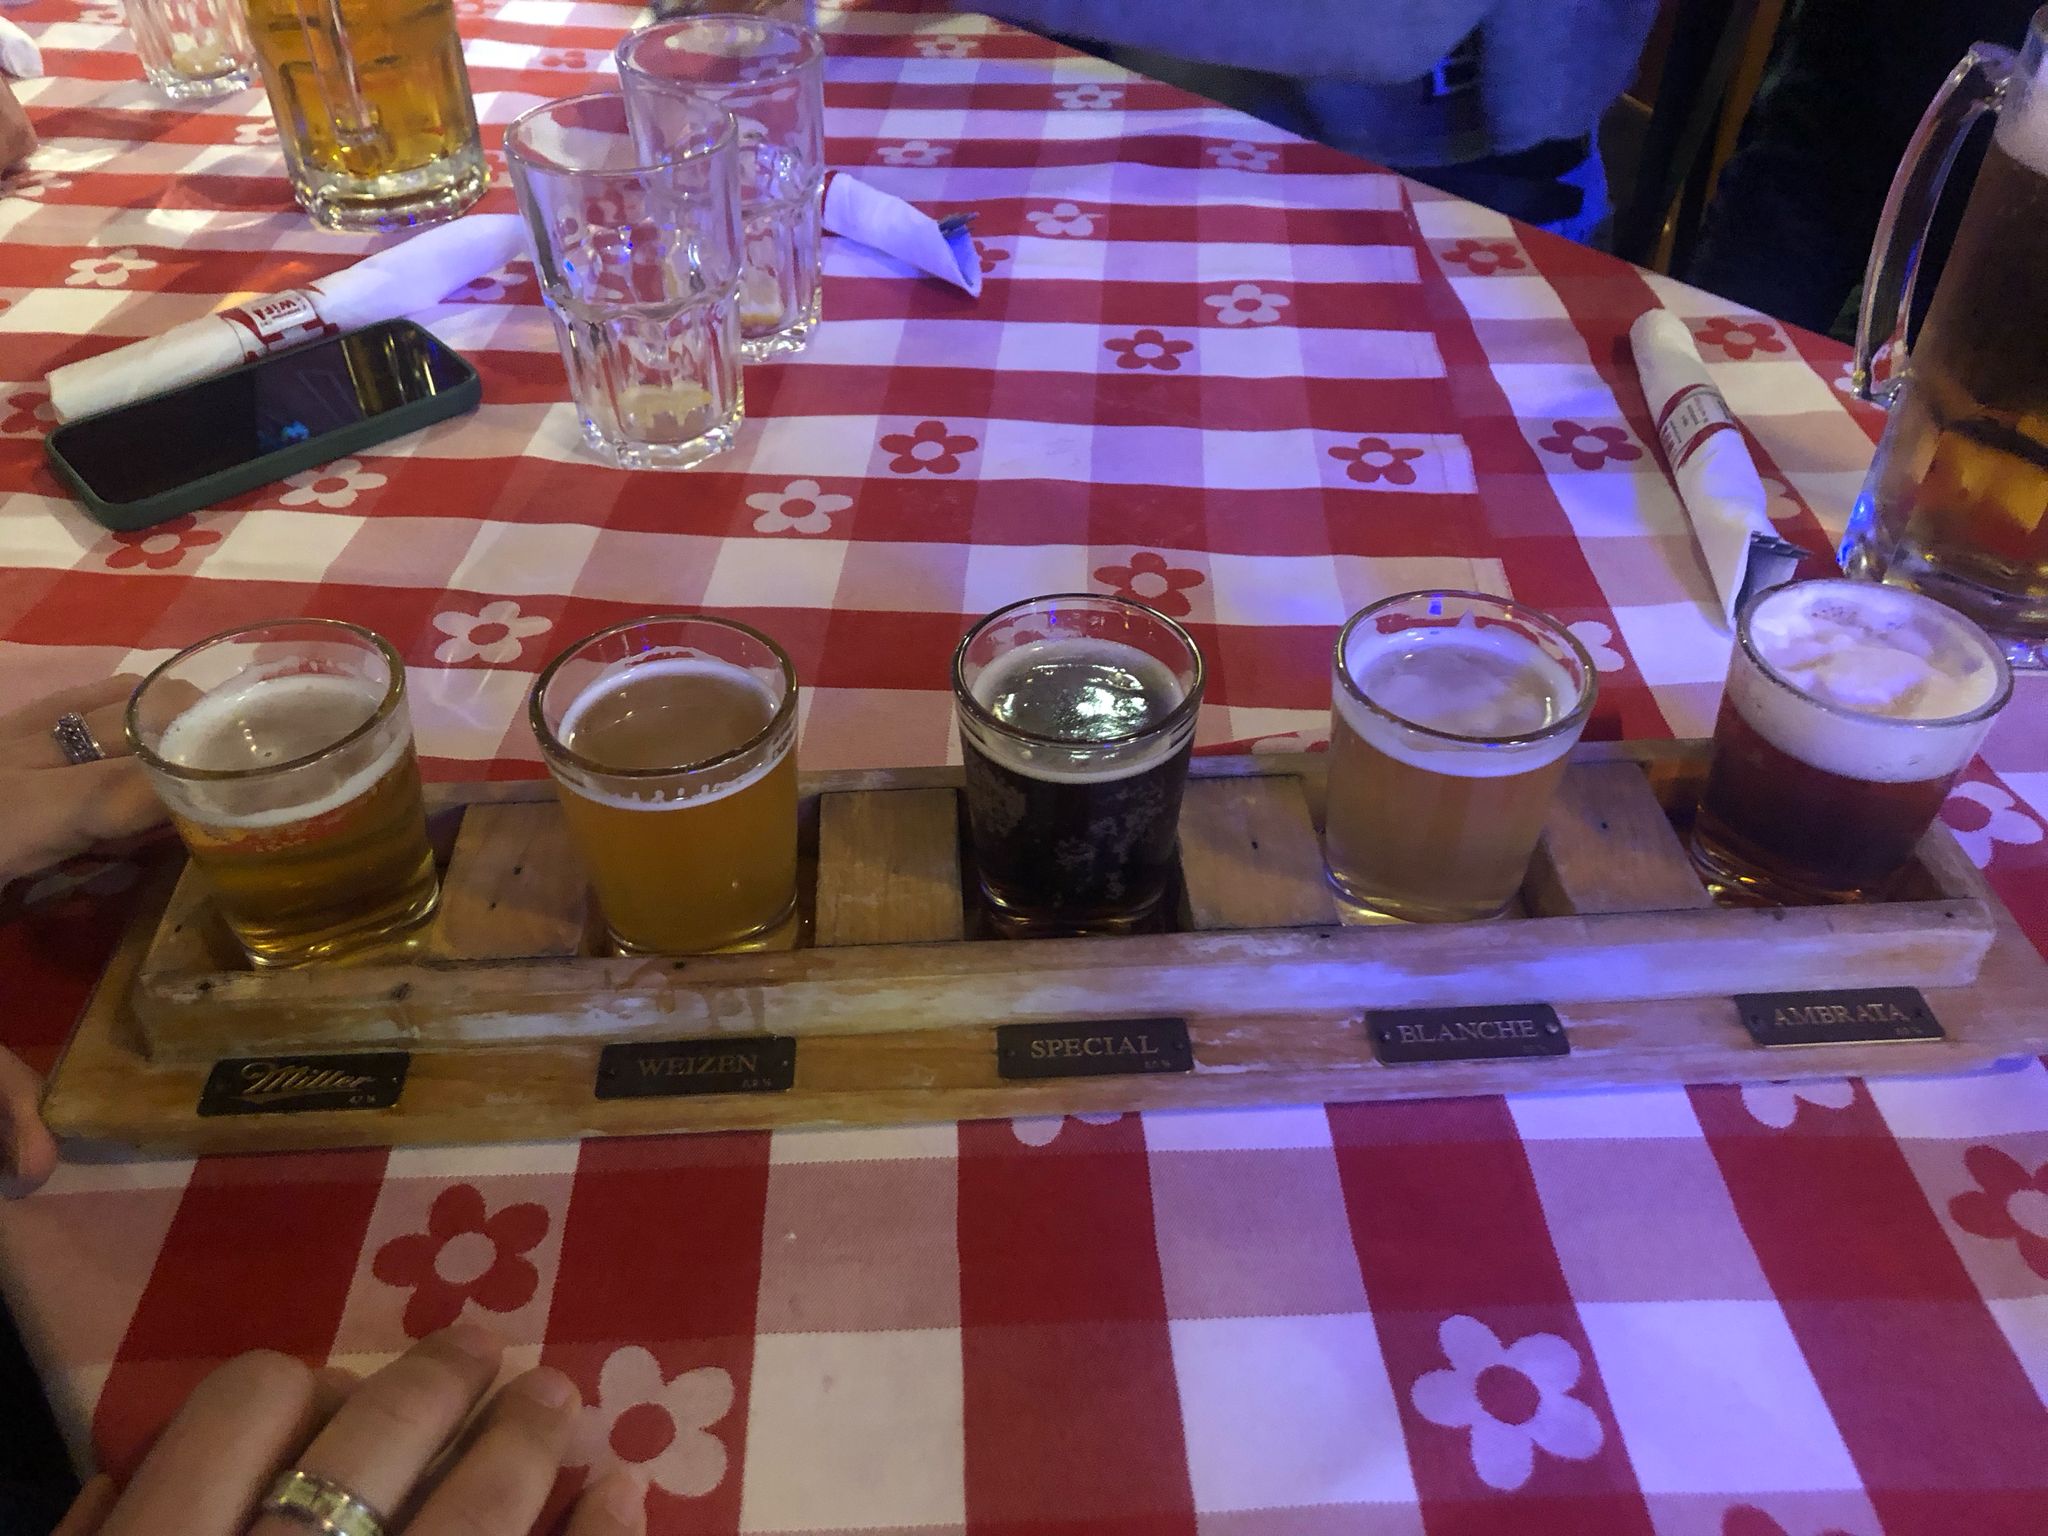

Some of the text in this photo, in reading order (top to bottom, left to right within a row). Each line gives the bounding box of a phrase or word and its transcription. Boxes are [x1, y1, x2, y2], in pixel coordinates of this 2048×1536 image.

[1775, 1003, 1911, 1026] AMBRATA
[1396, 1019, 1539, 1043] BLANCHE
[1031, 1035, 1159, 1060] SPECIAL
[638, 1054, 758, 1077] WEIZEN
[241, 1062, 377, 1095] Miller
